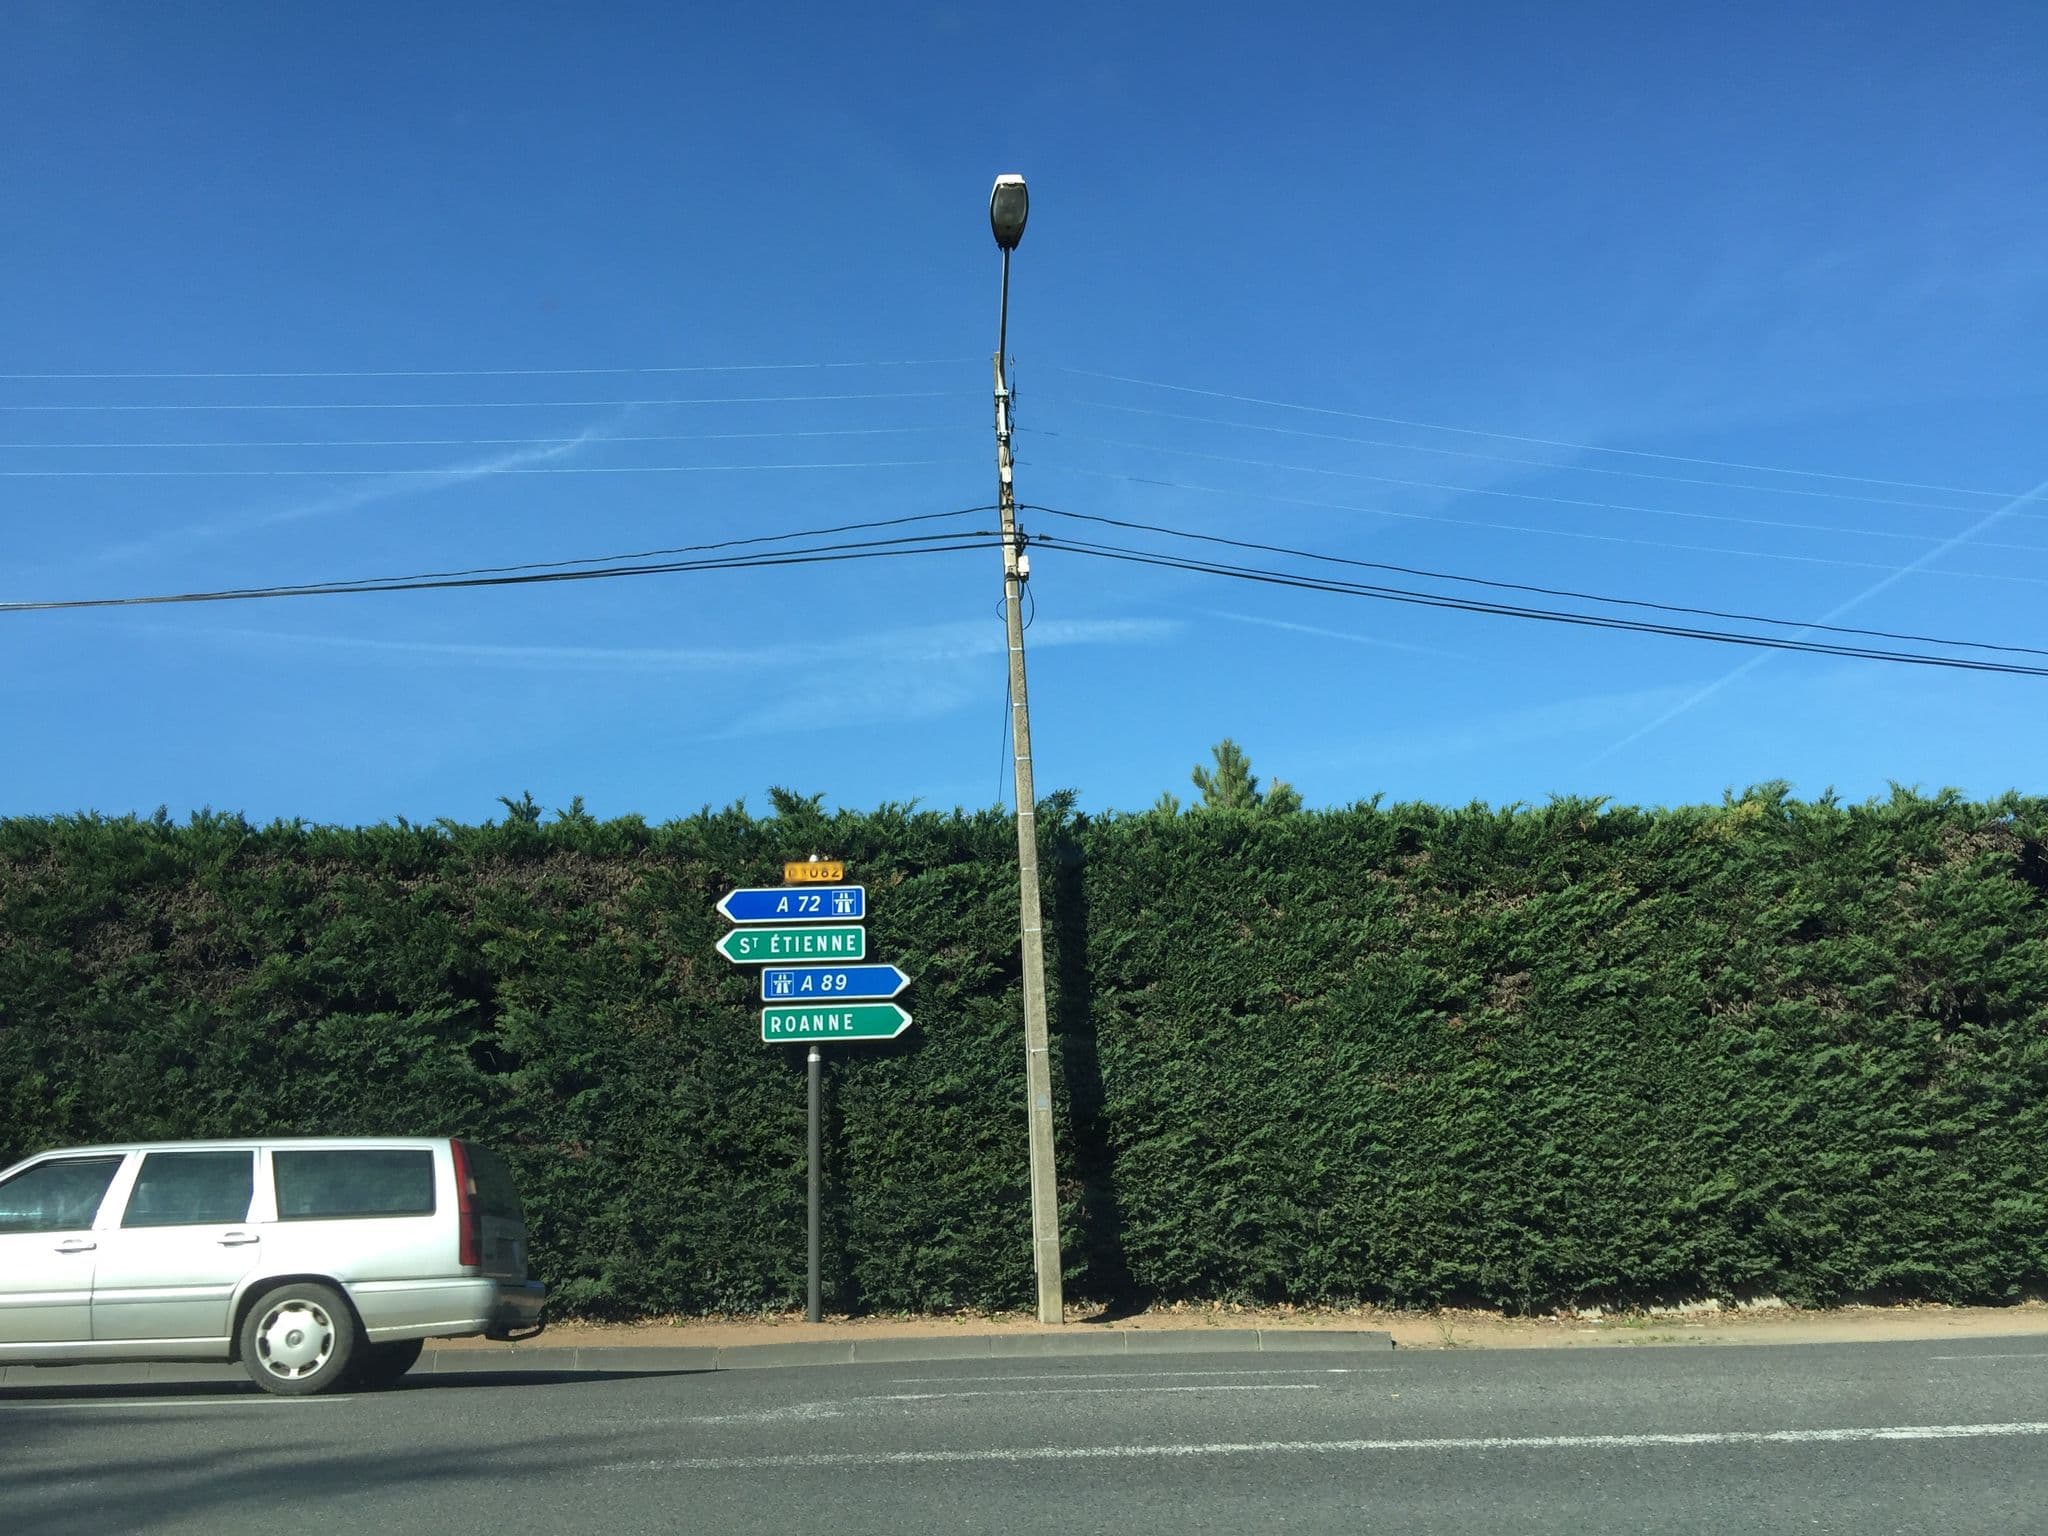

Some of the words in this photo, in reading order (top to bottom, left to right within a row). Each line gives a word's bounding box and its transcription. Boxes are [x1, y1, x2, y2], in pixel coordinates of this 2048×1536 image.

[776, 897, 789, 913] A
[798, 896, 821, 912] 72
[770, 934, 856, 953] ÉTIENNE
[800, 975, 814, 991] A
[821, 974, 847, 991] 89
[770, 1014, 854, 1033] ROANNE
